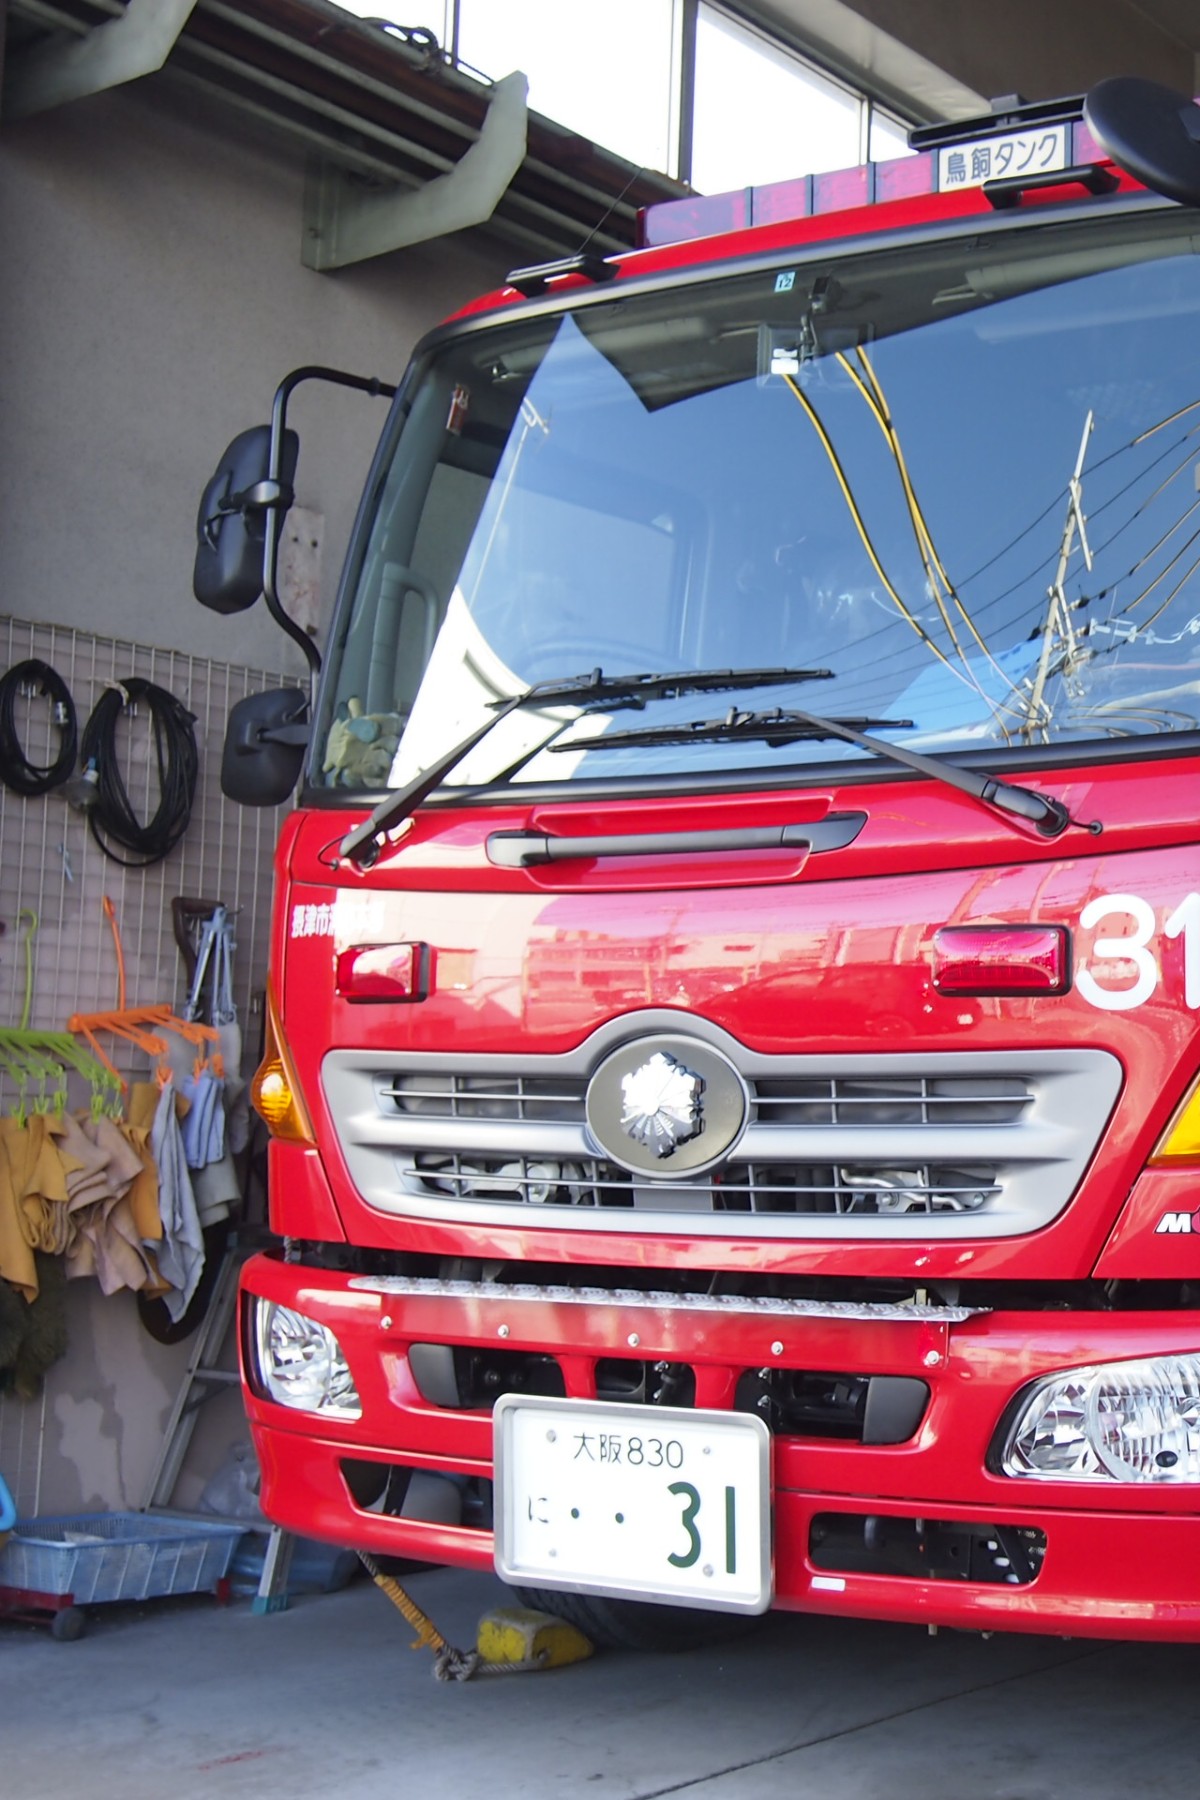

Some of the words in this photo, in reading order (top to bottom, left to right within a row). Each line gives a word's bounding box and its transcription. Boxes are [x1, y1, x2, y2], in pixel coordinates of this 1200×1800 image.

[945, 133, 1058, 185] 鳥飼タンク
